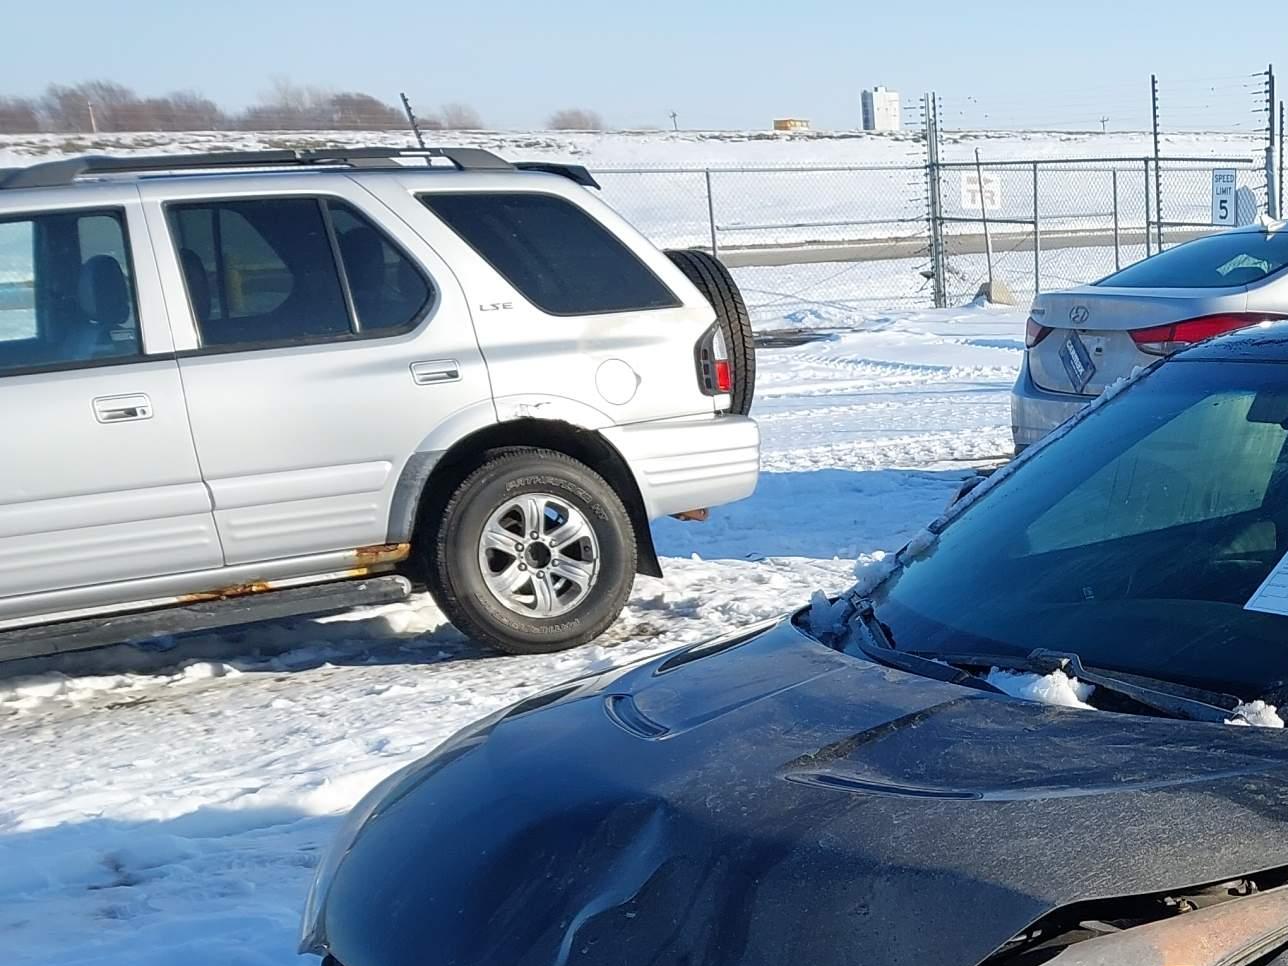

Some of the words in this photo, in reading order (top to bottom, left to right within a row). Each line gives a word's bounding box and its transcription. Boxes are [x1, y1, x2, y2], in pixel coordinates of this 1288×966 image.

[1214, 174, 1235, 183] SPEED
[1215, 186, 1232, 196] LIMIT
[1219, 199, 1229, 220] 5
[479, 301, 513, 312] LSE
